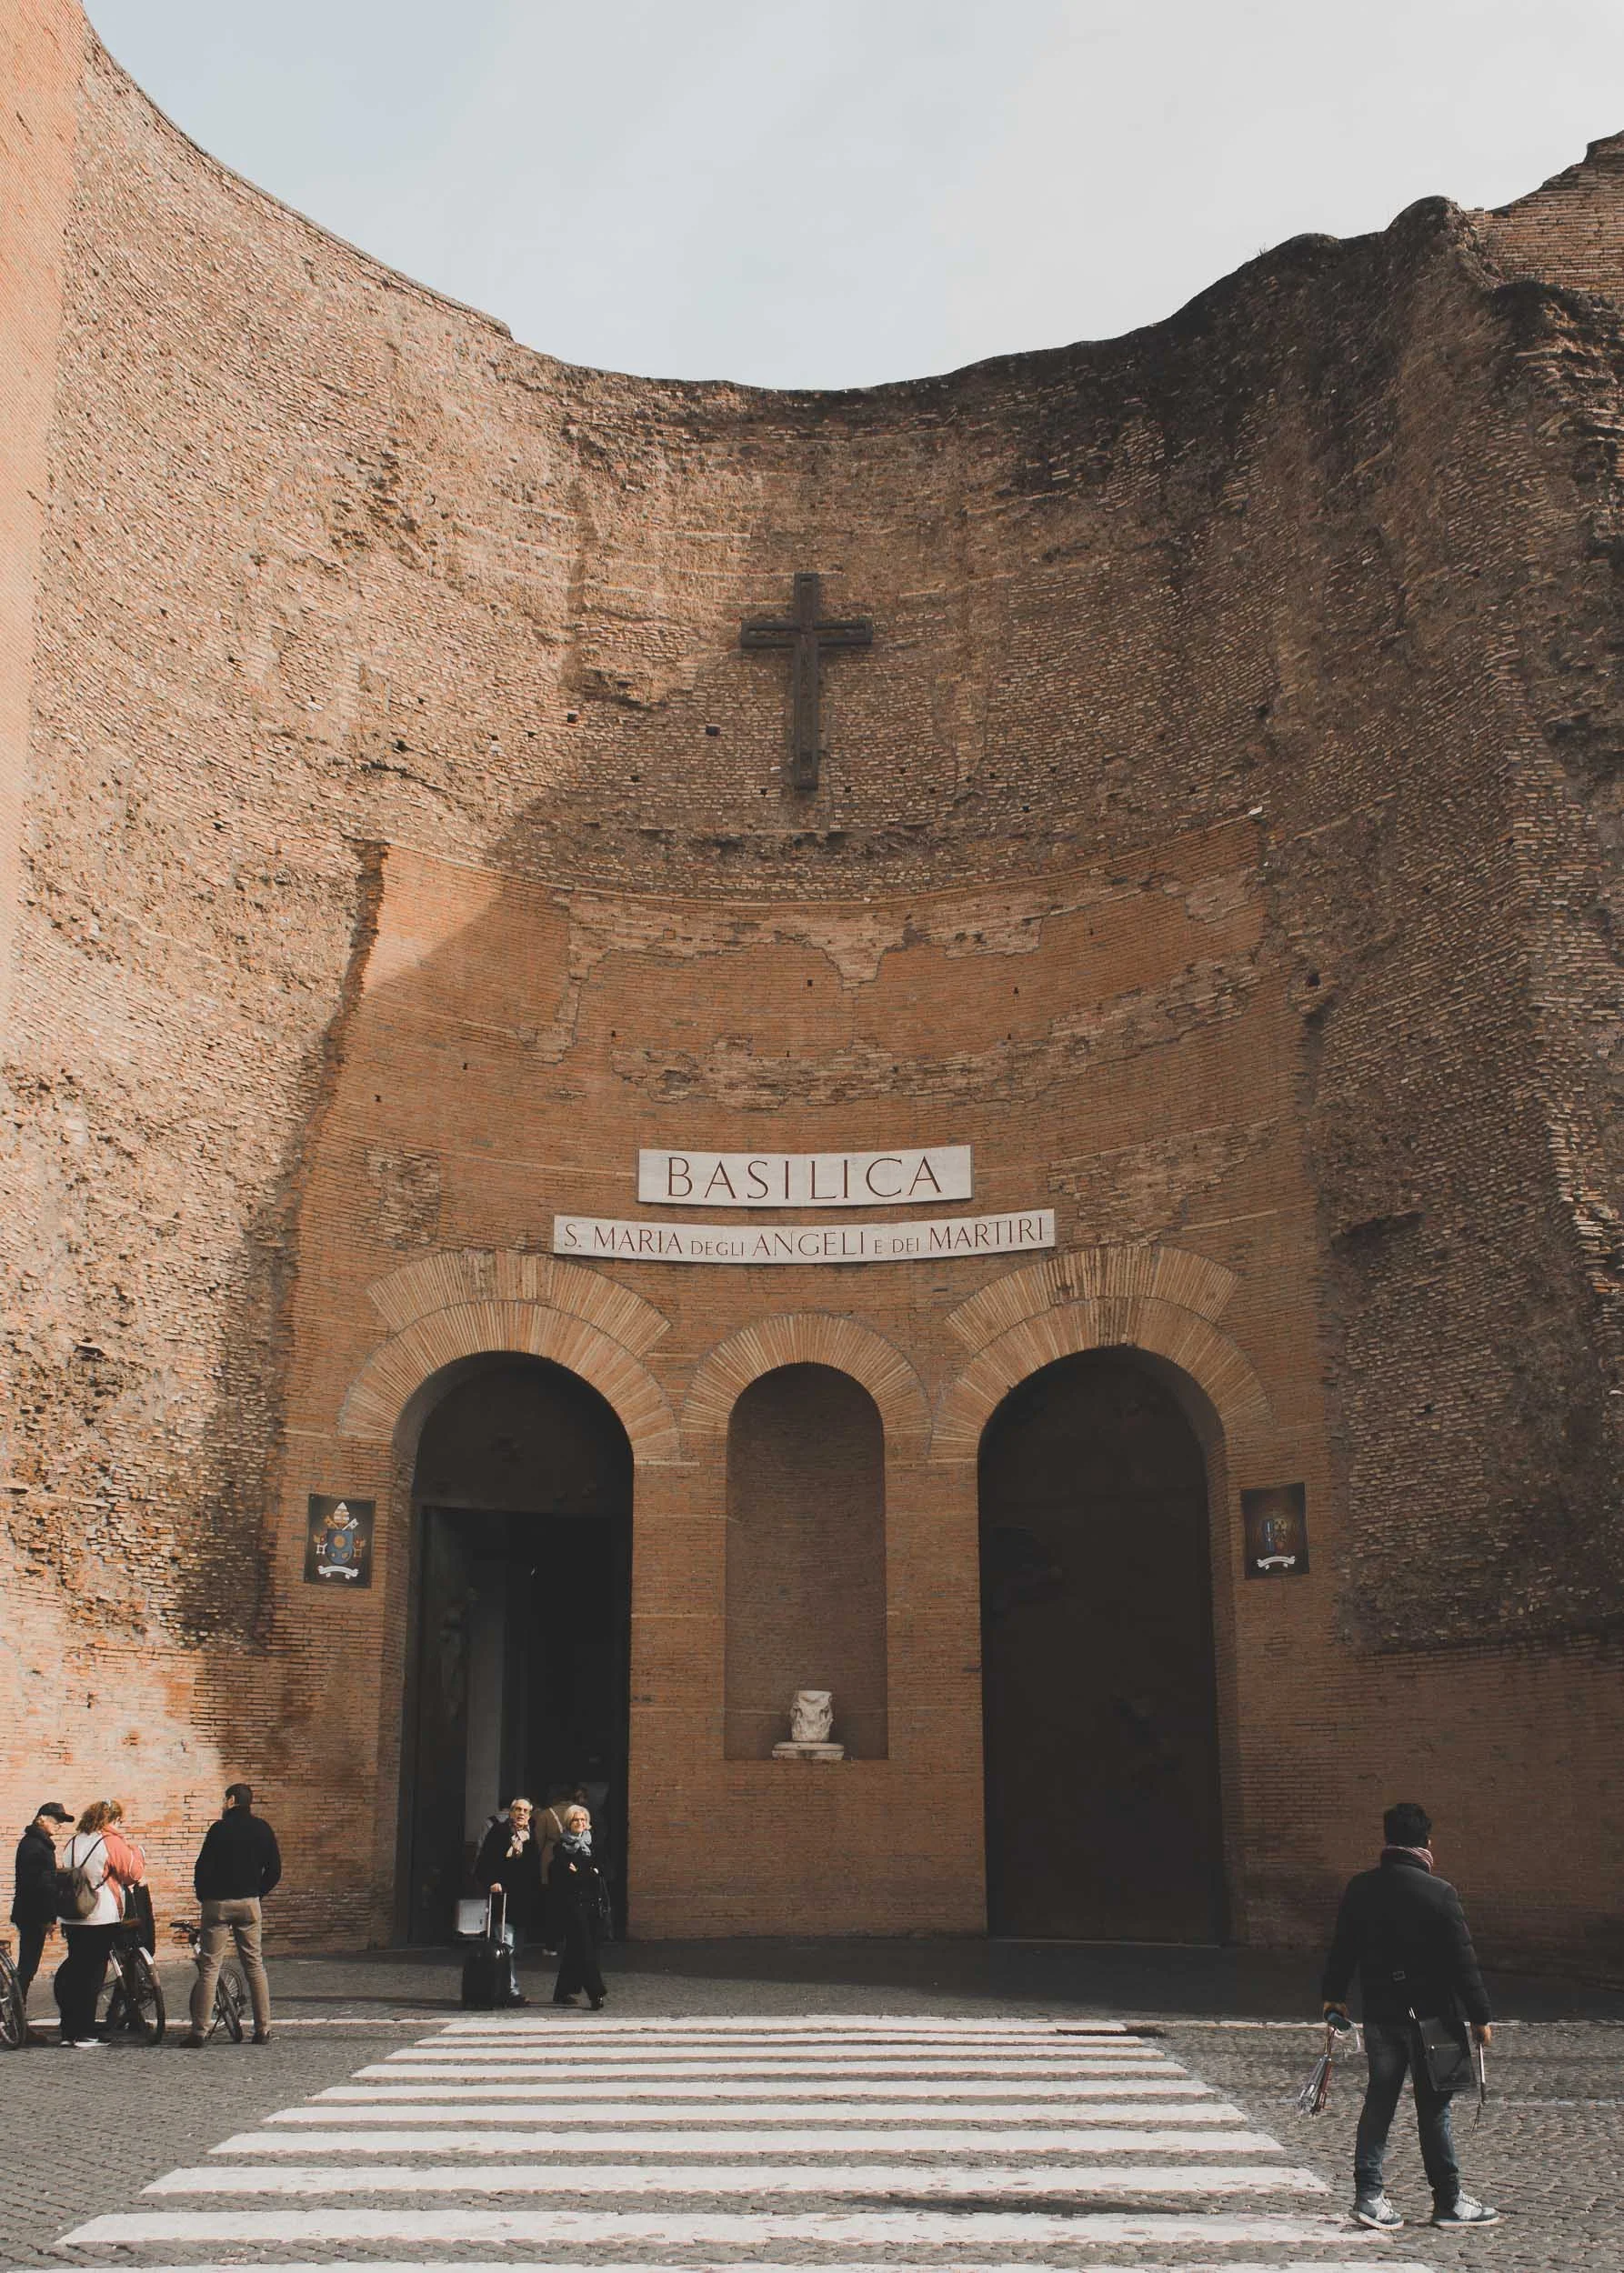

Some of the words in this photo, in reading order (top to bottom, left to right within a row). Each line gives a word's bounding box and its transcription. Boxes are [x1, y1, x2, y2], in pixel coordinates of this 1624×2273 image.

[667, 1156, 942, 1200] BASILICA
[565, 1224, 582, 1249] S.
[593, 1226, 683, 1255] MARIA
[690, 1240, 745, 1257] DEGLI
[752, 1231, 865, 1257] ANGELI
[875, 1238, 883, 1254] E
[892, 1237, 920, 1253] DEI
[928, 1217, 1044, 1251] MARTIRI
